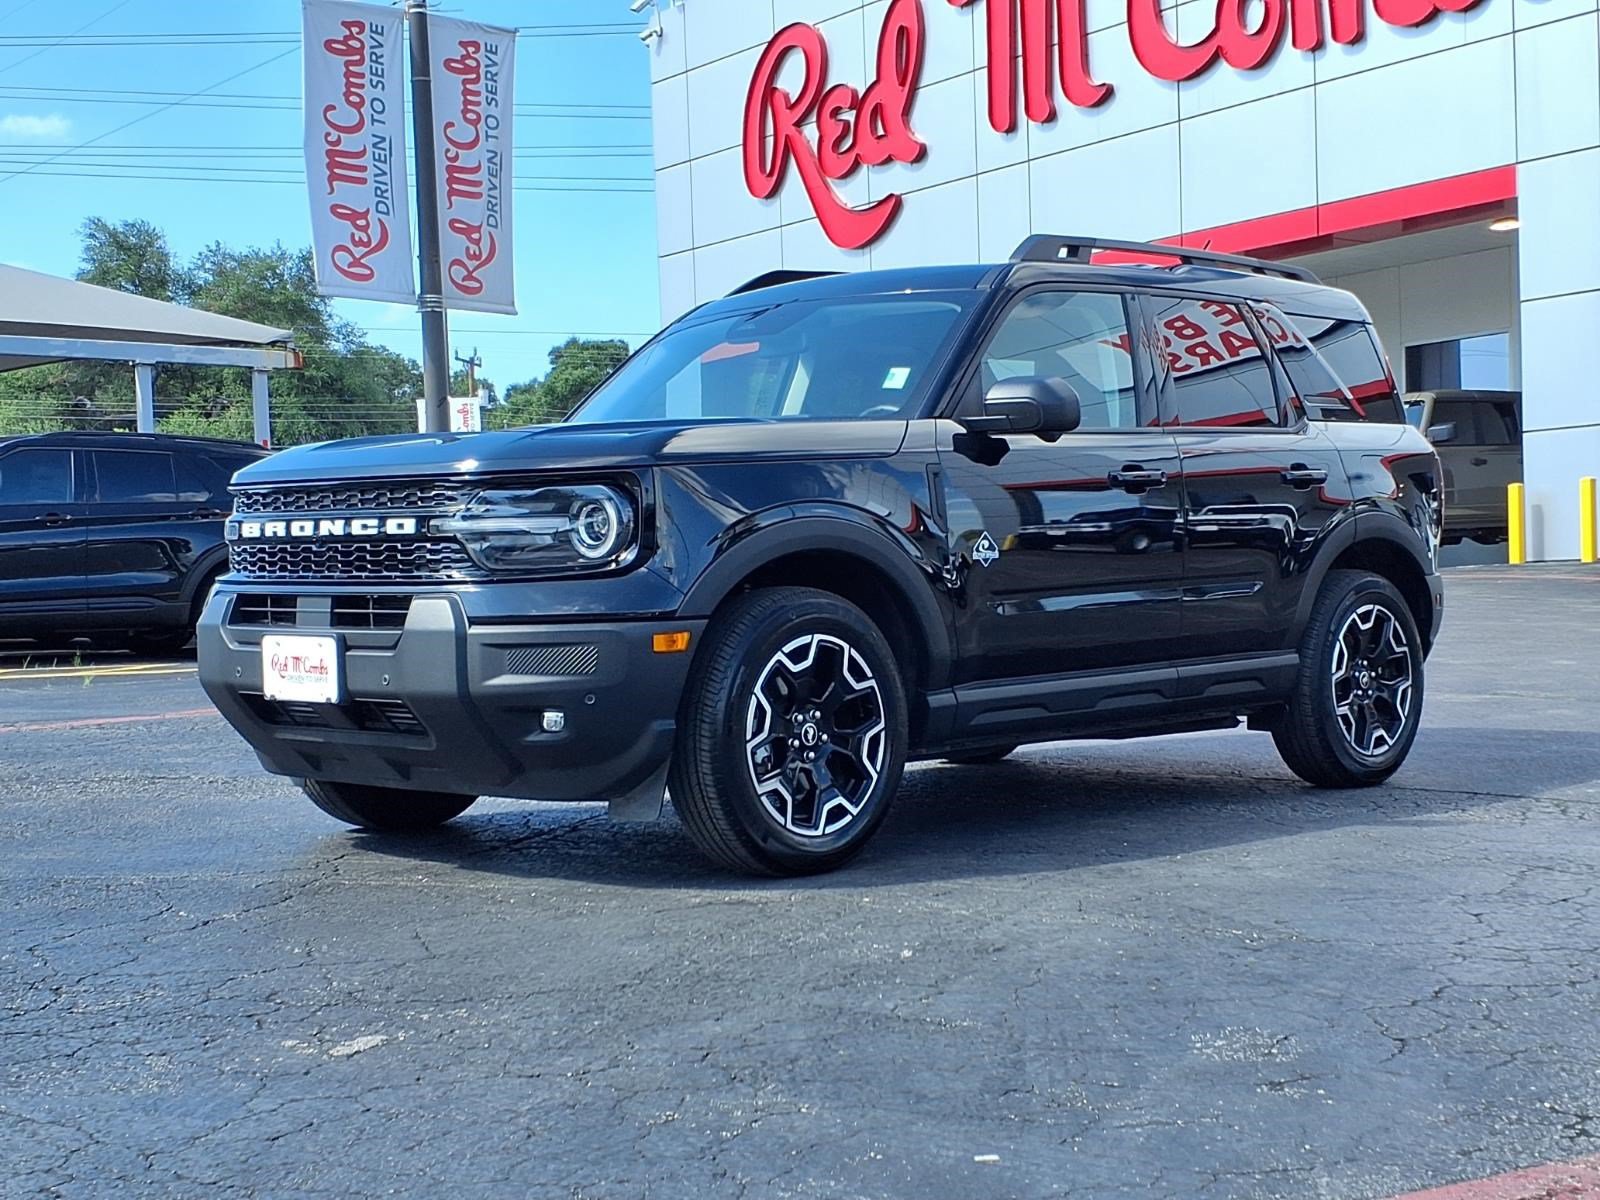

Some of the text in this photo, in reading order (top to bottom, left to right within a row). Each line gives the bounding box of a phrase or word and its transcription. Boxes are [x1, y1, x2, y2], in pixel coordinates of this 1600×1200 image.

[323, 19, 389, 282] Red McCombs
[370, 21, 393, 217] DRIVEN TO SERVE
[442, 39, 497, 296] Red McCombs
[484, 42, 500, 230] DRIVEN TO SERVE
[742, 0, 928, 250] Red
[241, 518, 416, 538] BRONCO
[271, 653, 289, 679] Red
